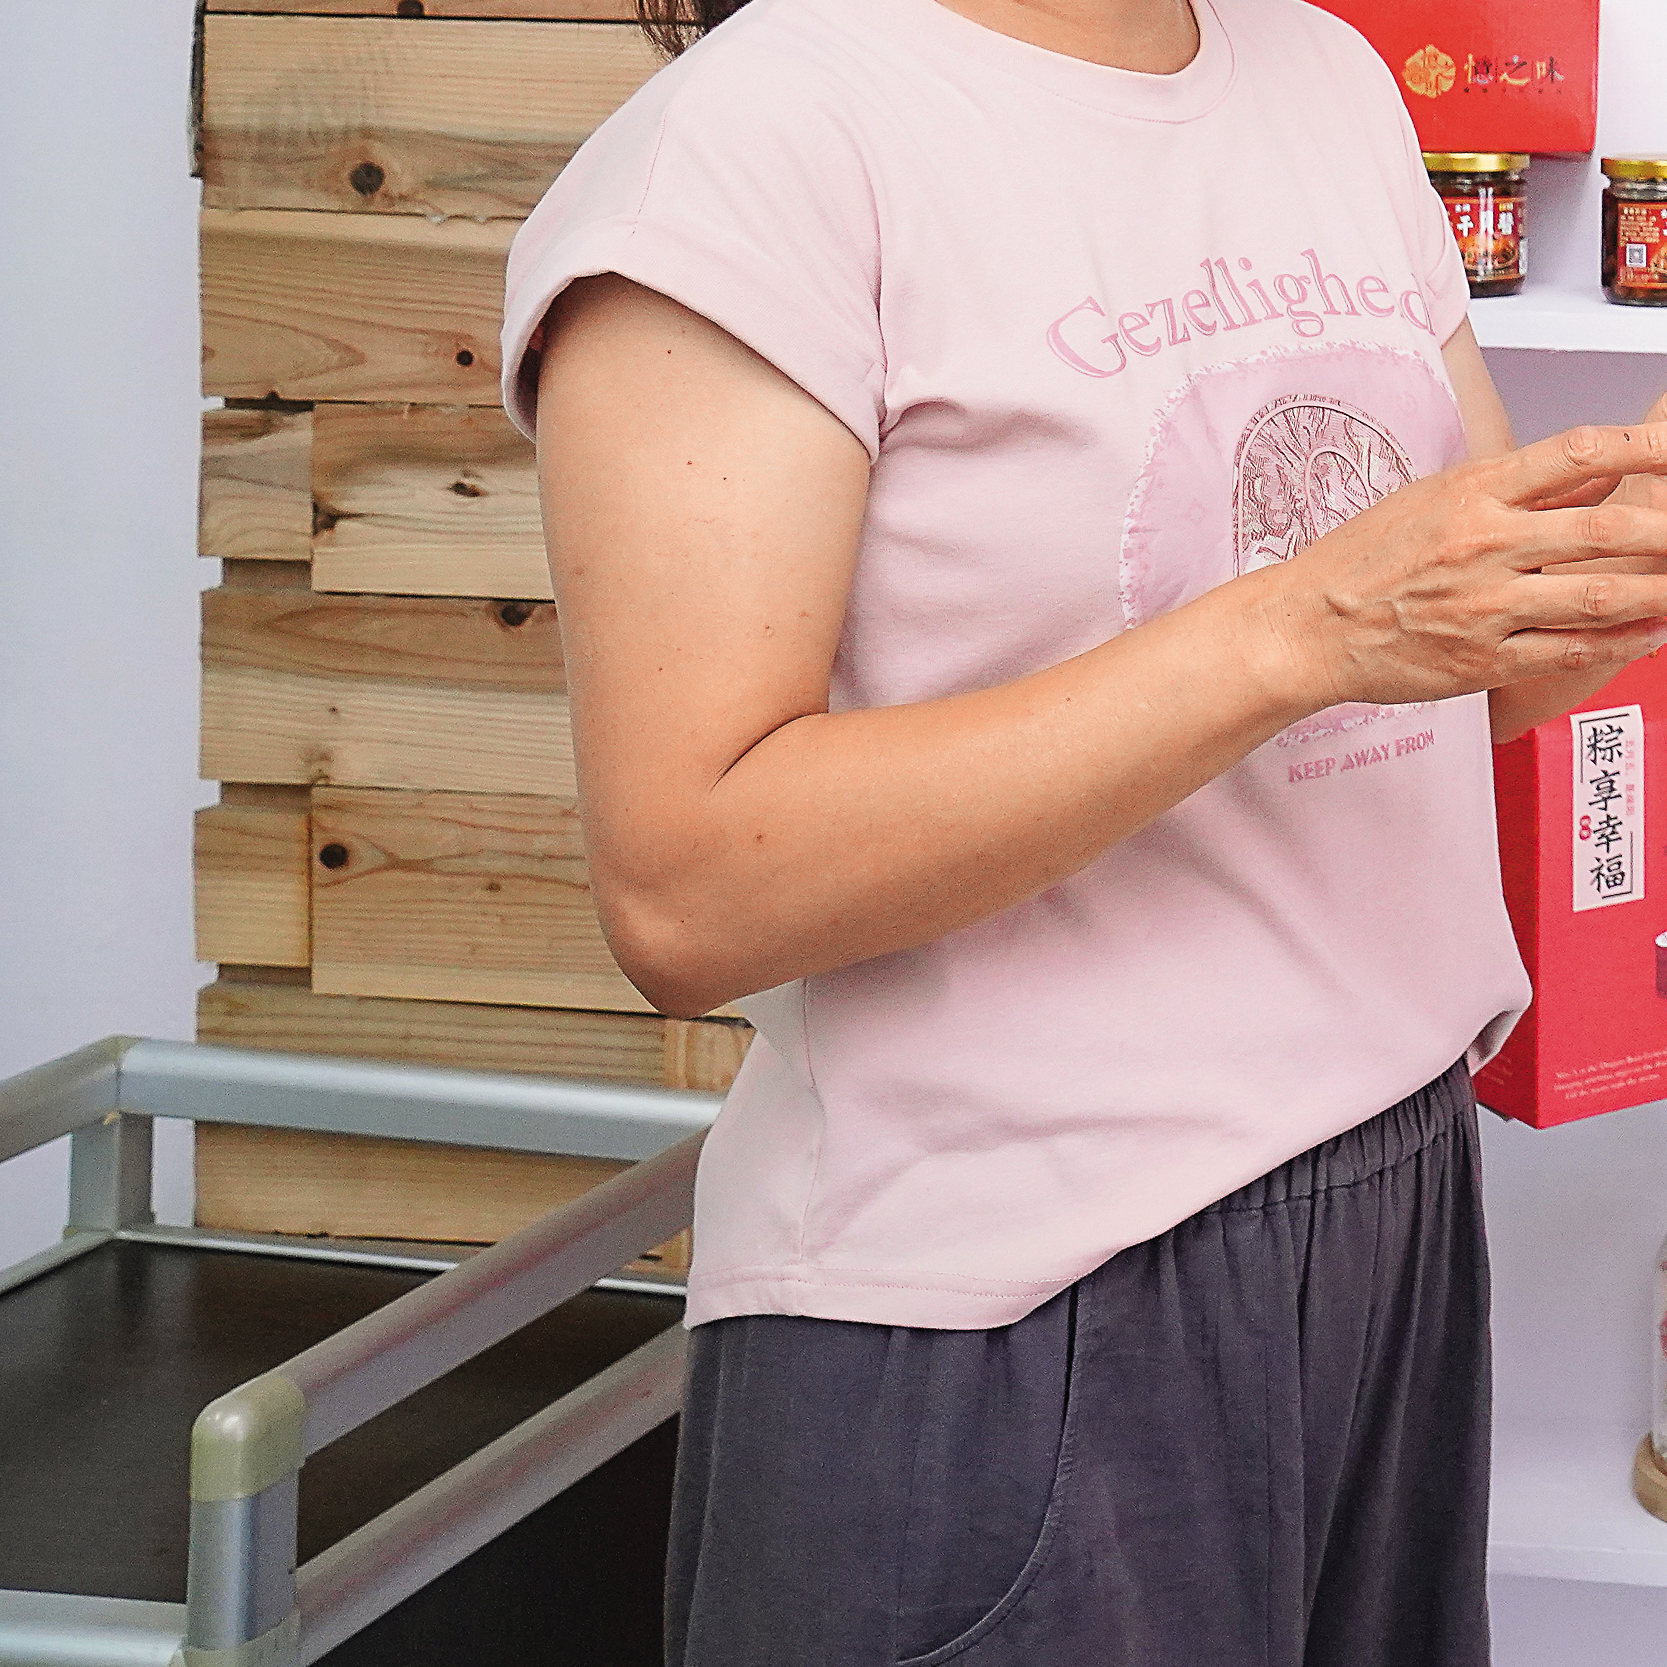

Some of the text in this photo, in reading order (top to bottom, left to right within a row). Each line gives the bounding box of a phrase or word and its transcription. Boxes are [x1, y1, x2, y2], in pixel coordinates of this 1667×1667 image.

[1288, 728, 1435, 783] KEEP AWAY FROM
[1586, 724, 1626, 894] 粽享幸福
